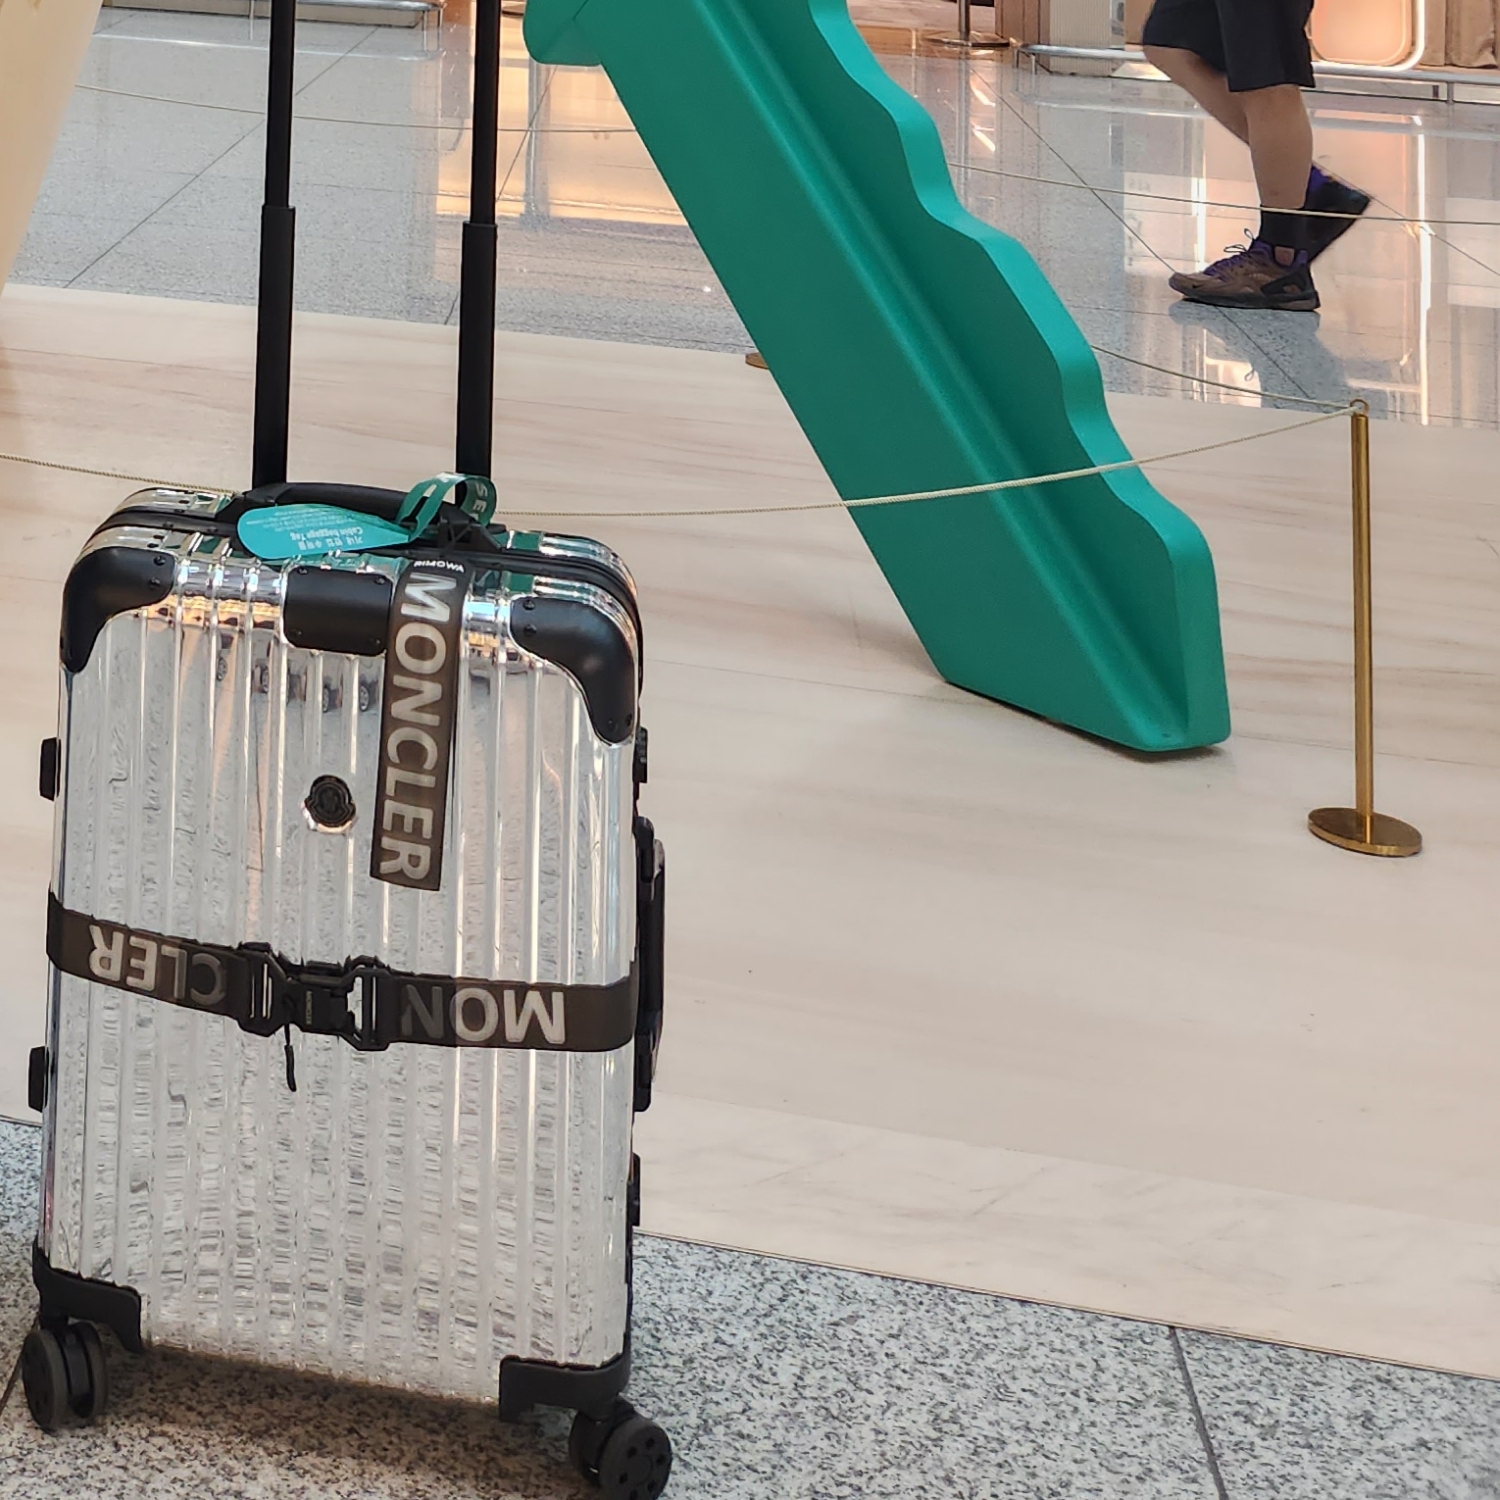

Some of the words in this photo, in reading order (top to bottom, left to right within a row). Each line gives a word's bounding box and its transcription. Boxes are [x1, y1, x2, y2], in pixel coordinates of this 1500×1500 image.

[340, 526, 363, 536] Cabin
[413, 560, 465, 573] RIMOWA
[379, 572, 457, 881] MONCLER
